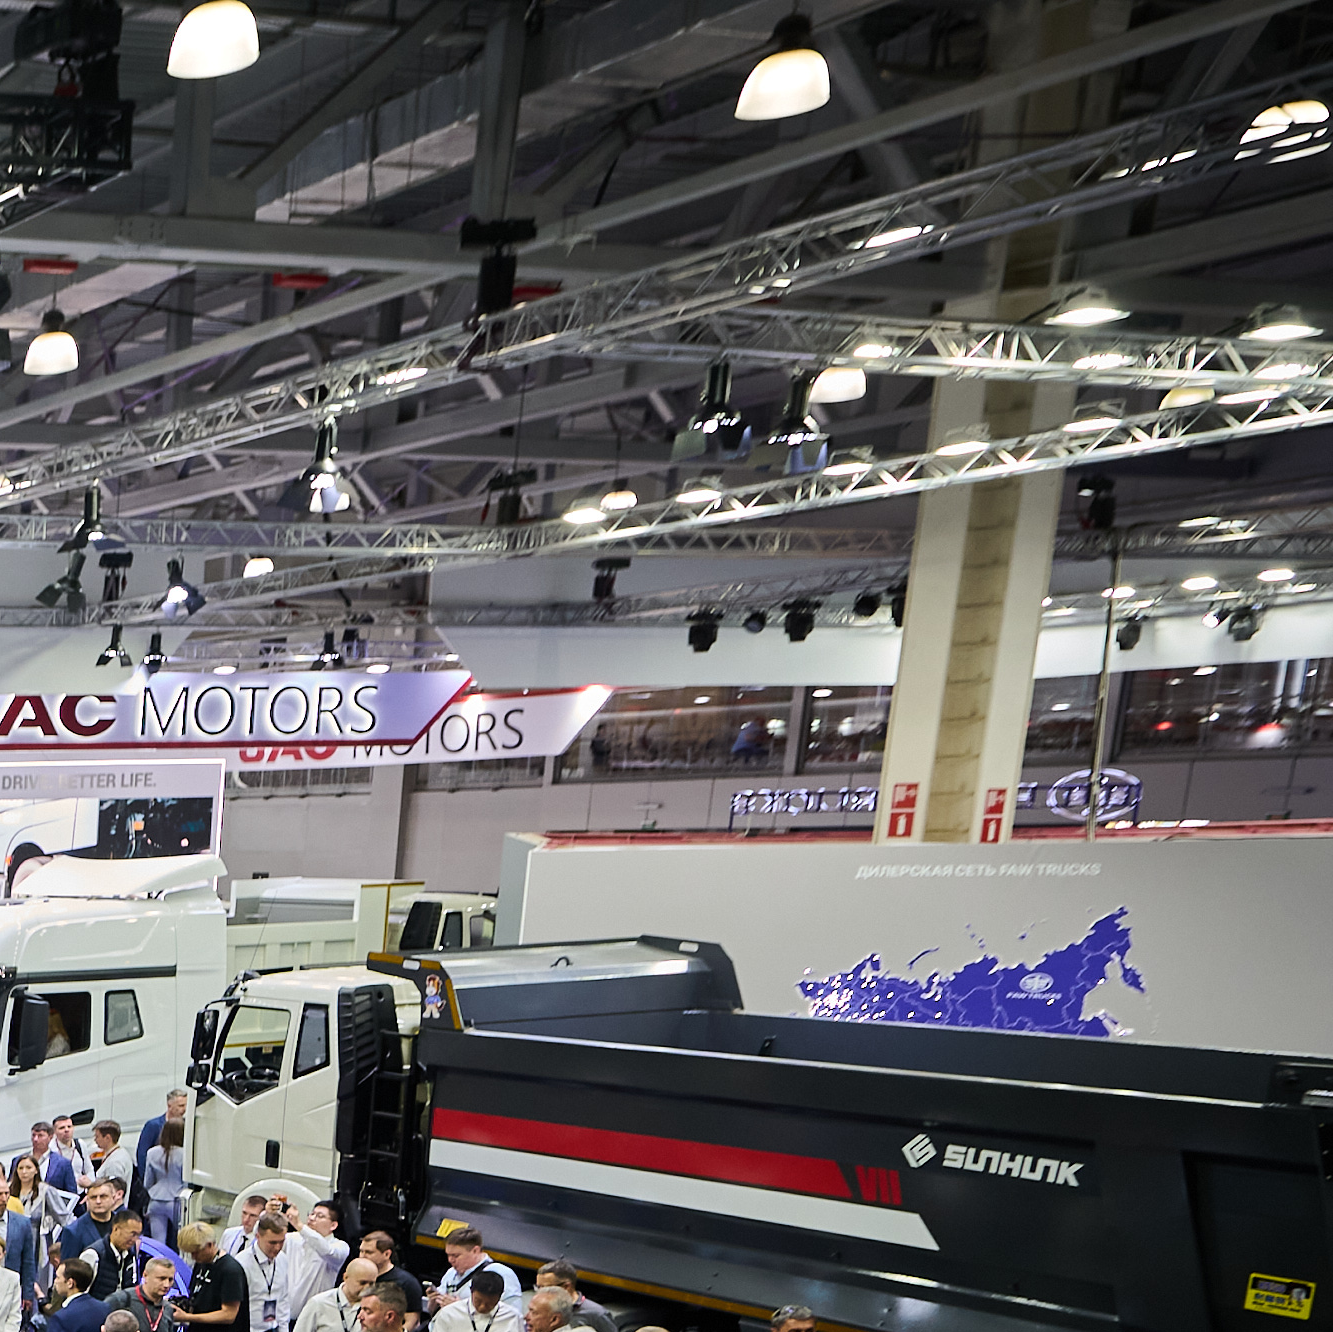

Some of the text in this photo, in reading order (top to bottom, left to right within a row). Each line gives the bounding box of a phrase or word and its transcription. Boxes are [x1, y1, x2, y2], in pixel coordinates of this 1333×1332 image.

[139, 683, 377, 738] MOTORS
[120, 772, 157, 788] LIFE.
[855, 862, 1103, 880] ДИЛЕРСКАЯ СЕТЬ FAW TRUCKS
